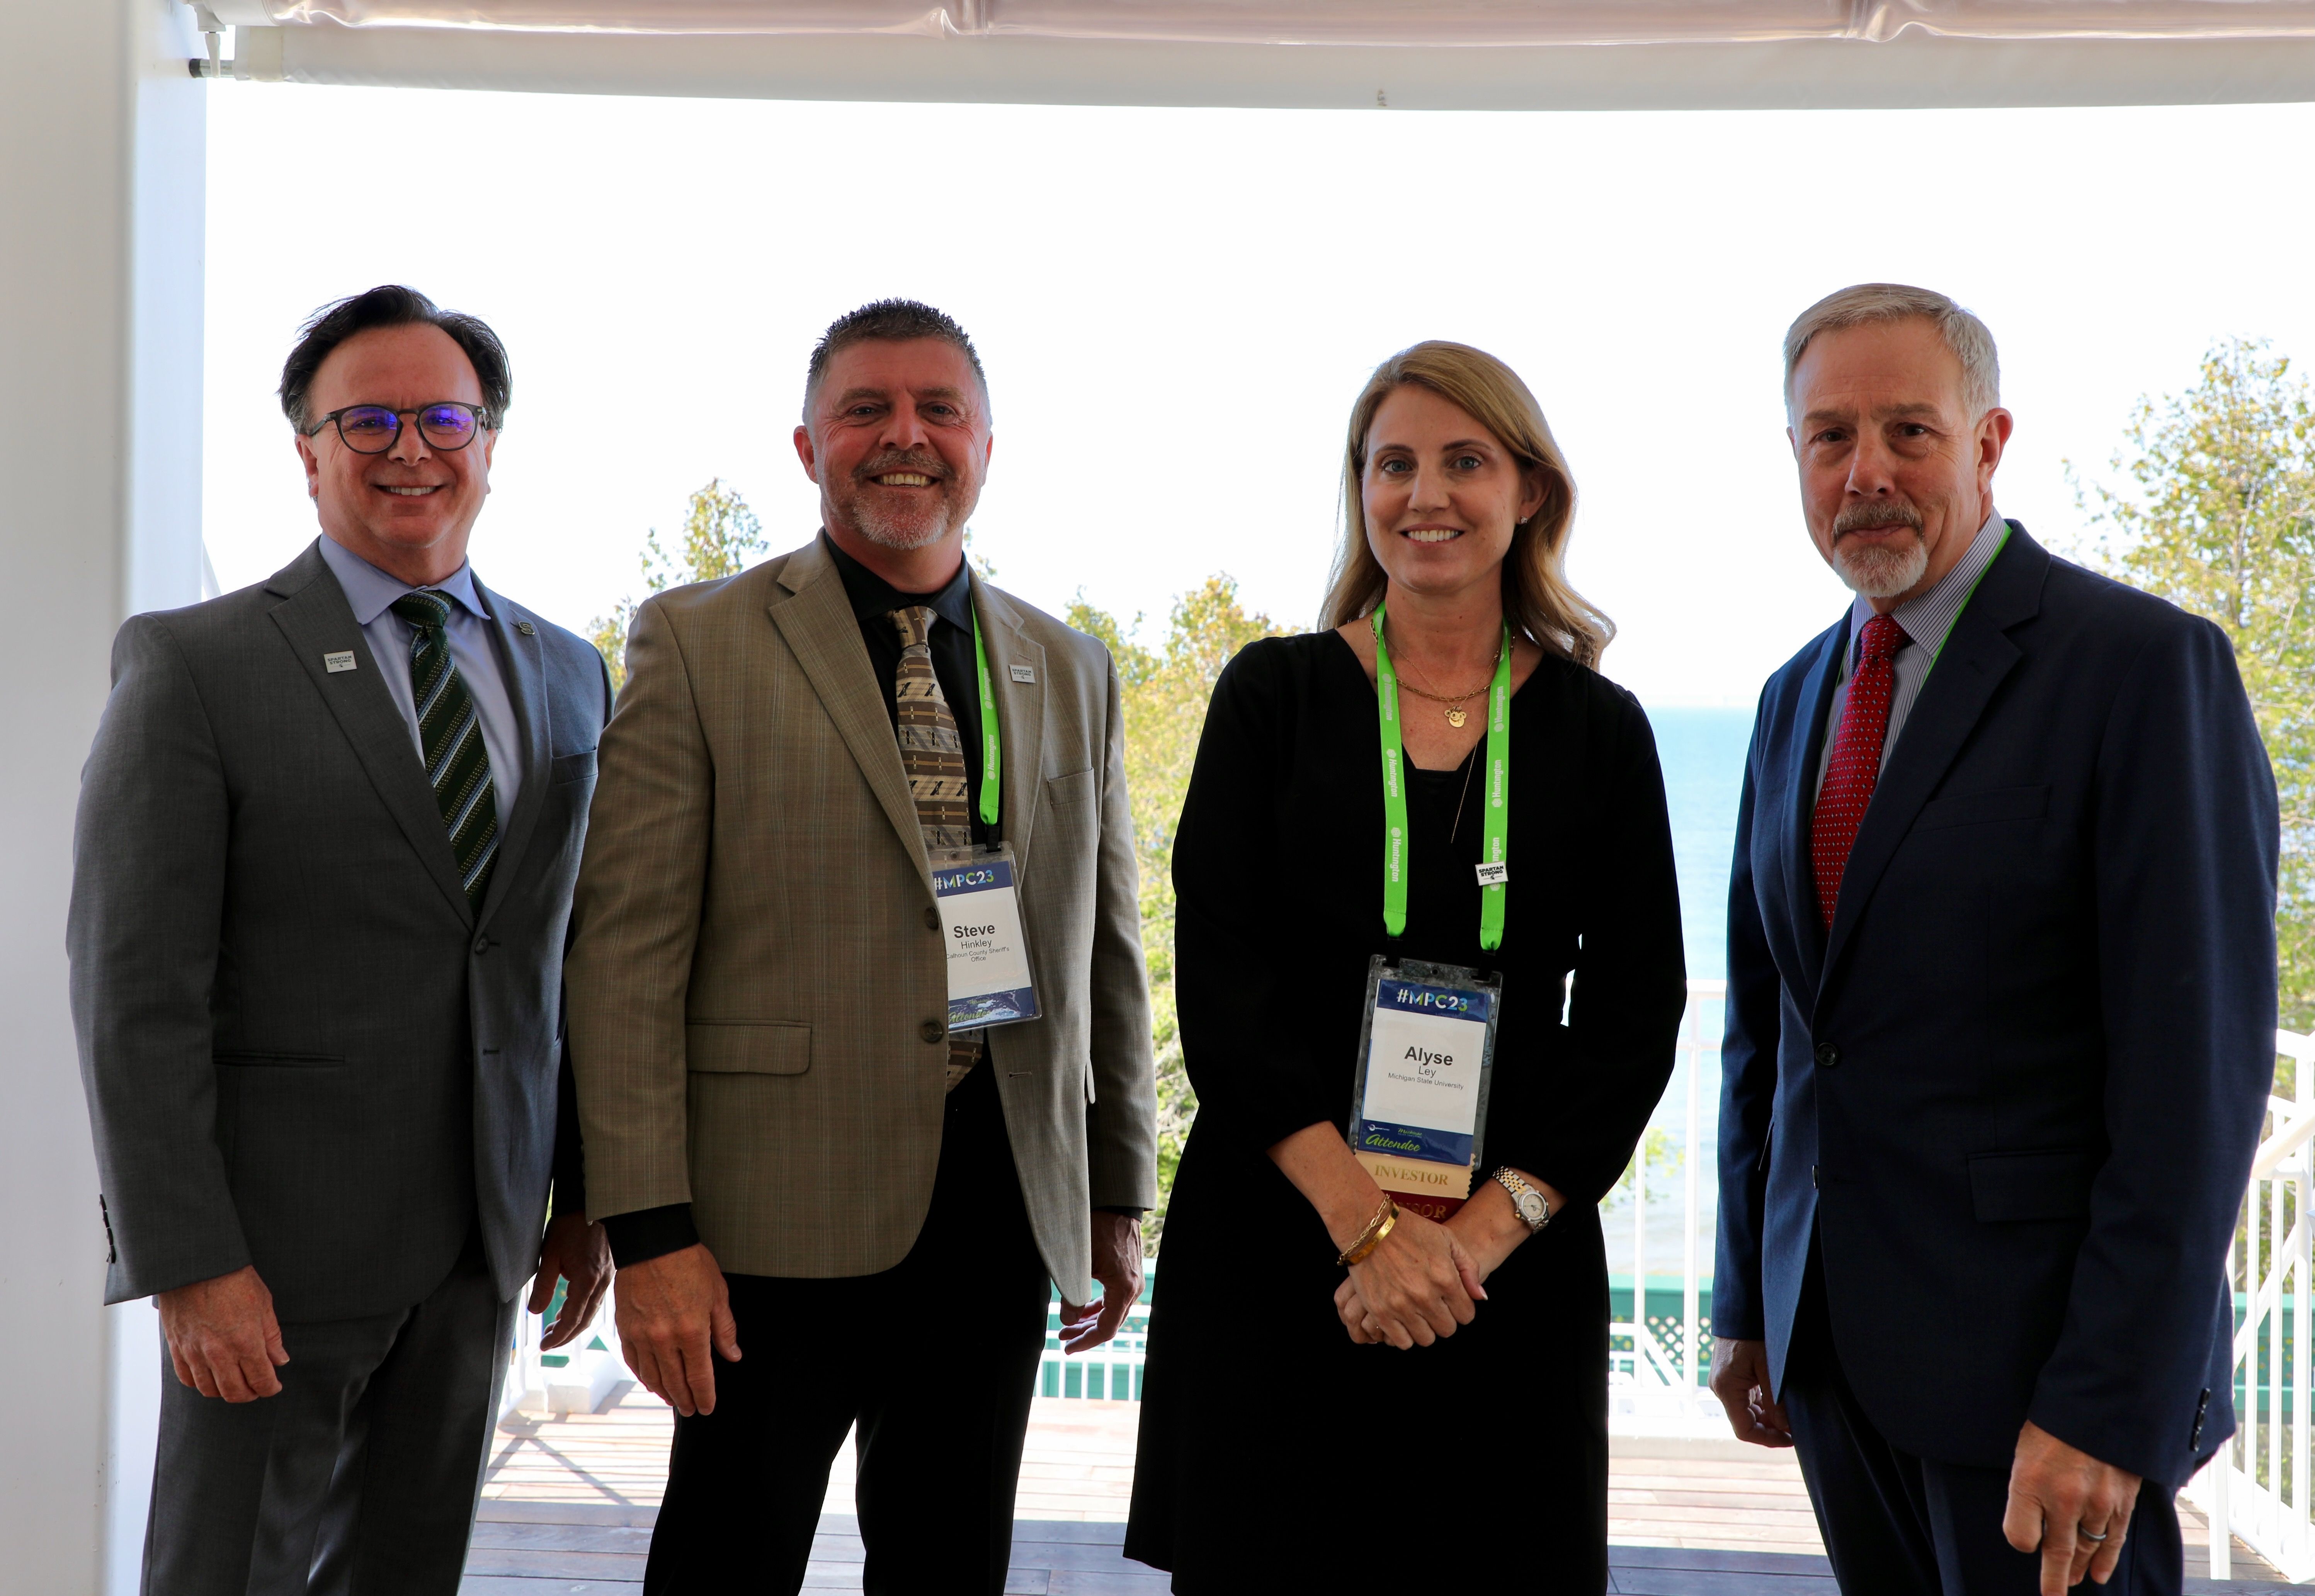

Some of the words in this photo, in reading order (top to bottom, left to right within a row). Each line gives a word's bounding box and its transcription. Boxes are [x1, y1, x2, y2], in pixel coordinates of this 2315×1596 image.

[1494, 686, 1505, 723] Huntington
[988, 734, 996, 770] Huntington
[1388, 759, 1398, 797] Huntington
[1492, 760, 1503, 797] Huntington
[1390, 838, 1401, 882] Huntington
[934, 870, 994, 890] #MPC23
[954, 925, 995, 938] Steve
[961, 939, 992, 949] Hinkley
[1396, 989, 1467, 1011] #MPC23
[1404, 1046, 1453, 1066] Alyse
[1388, 1072, 1415, 1082] Michigan
[1434, 1080, 1464, 1091] University
[1419, 1066, 1436, 1078] Ley
[1375, 1165, 1448, 1185] INVESTOR
